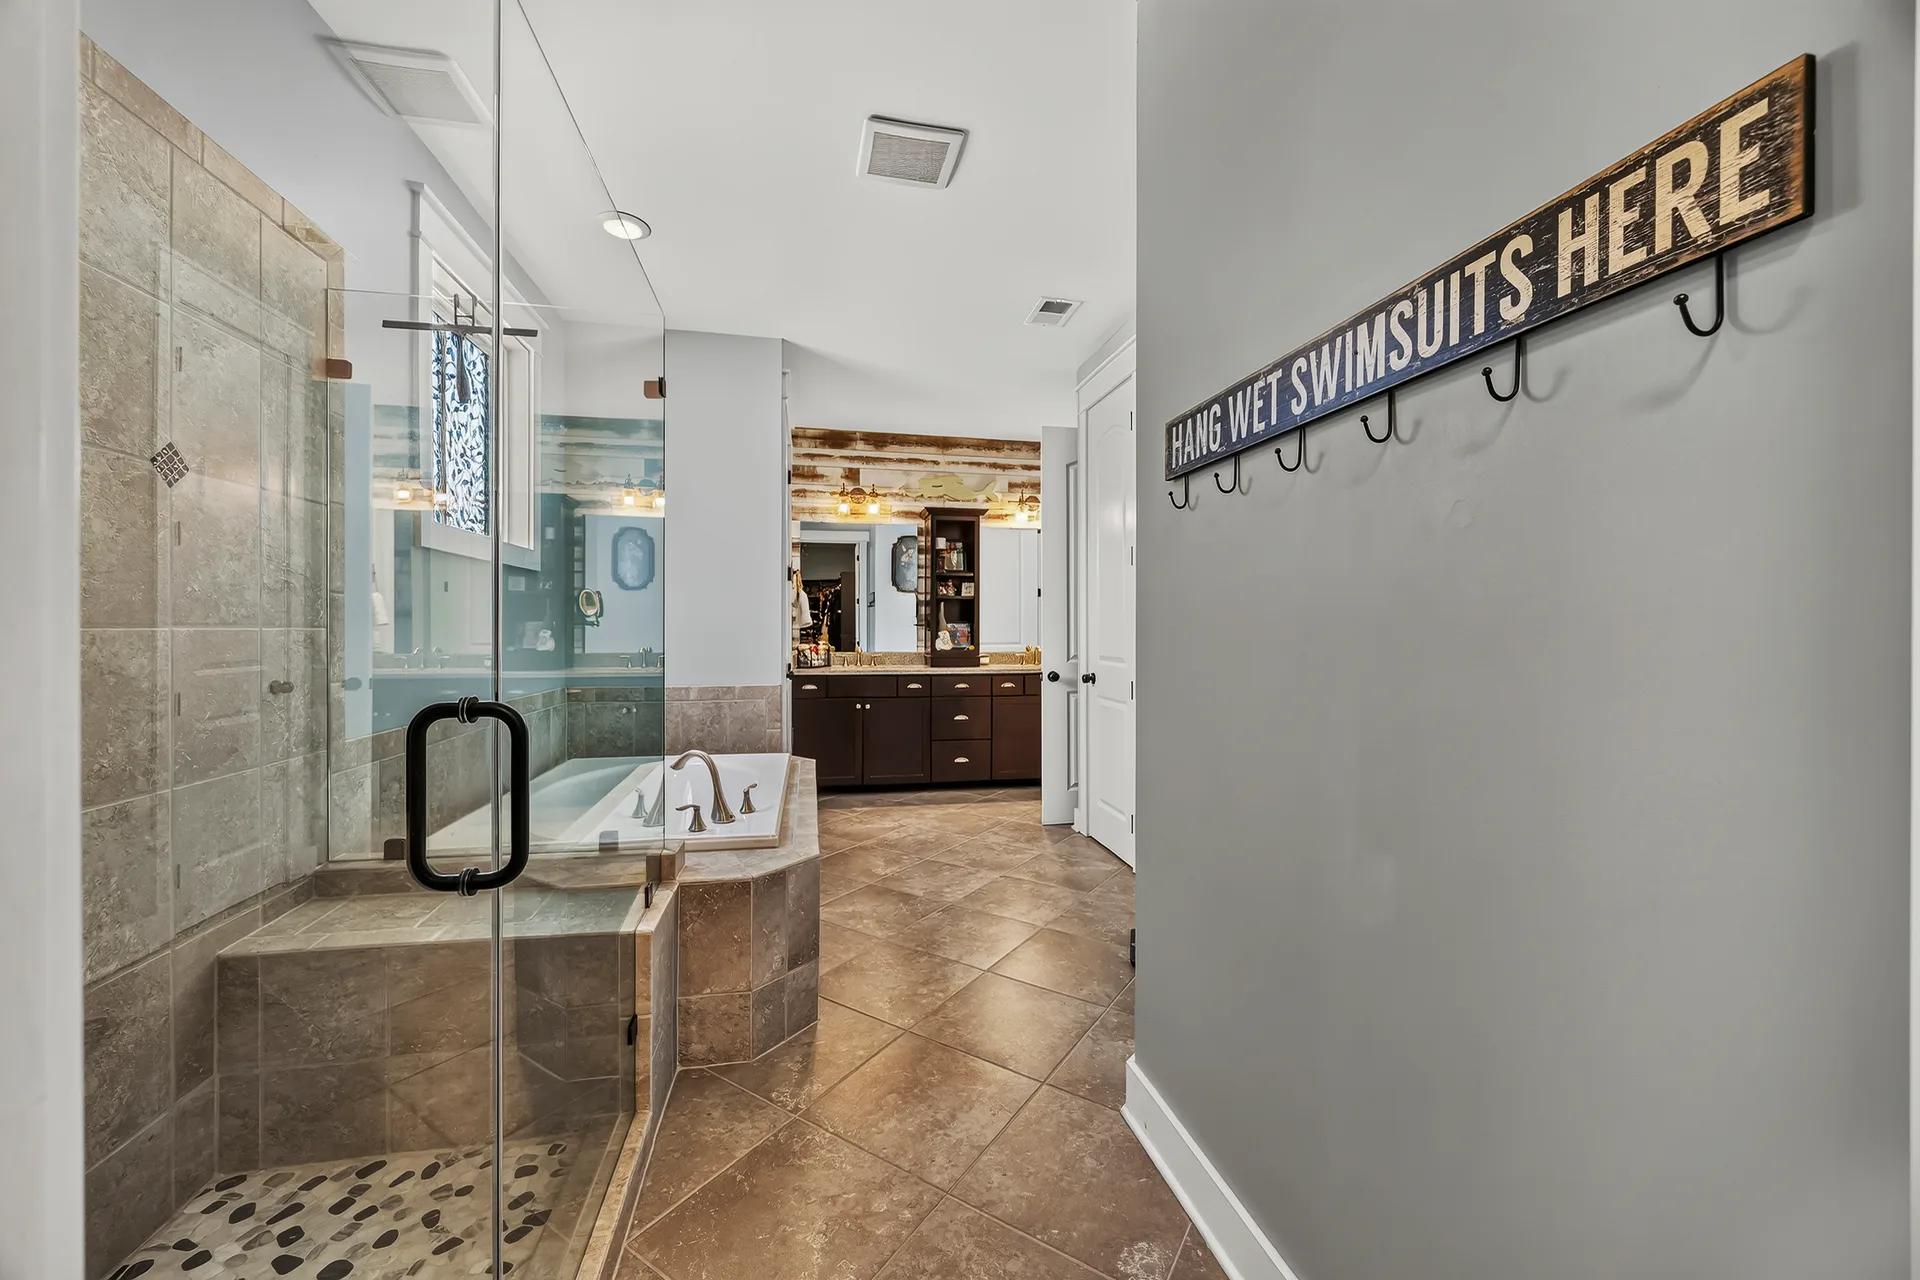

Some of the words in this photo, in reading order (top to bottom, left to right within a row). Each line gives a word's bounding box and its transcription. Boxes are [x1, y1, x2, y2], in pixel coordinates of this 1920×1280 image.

[1171, 403, 1222, 469] HANG
[1228, 368, 1283, 443] WET
[1290, 234, 1534, 416] SWIMSUITS
[1557, 97, 1771, 299] HERE
